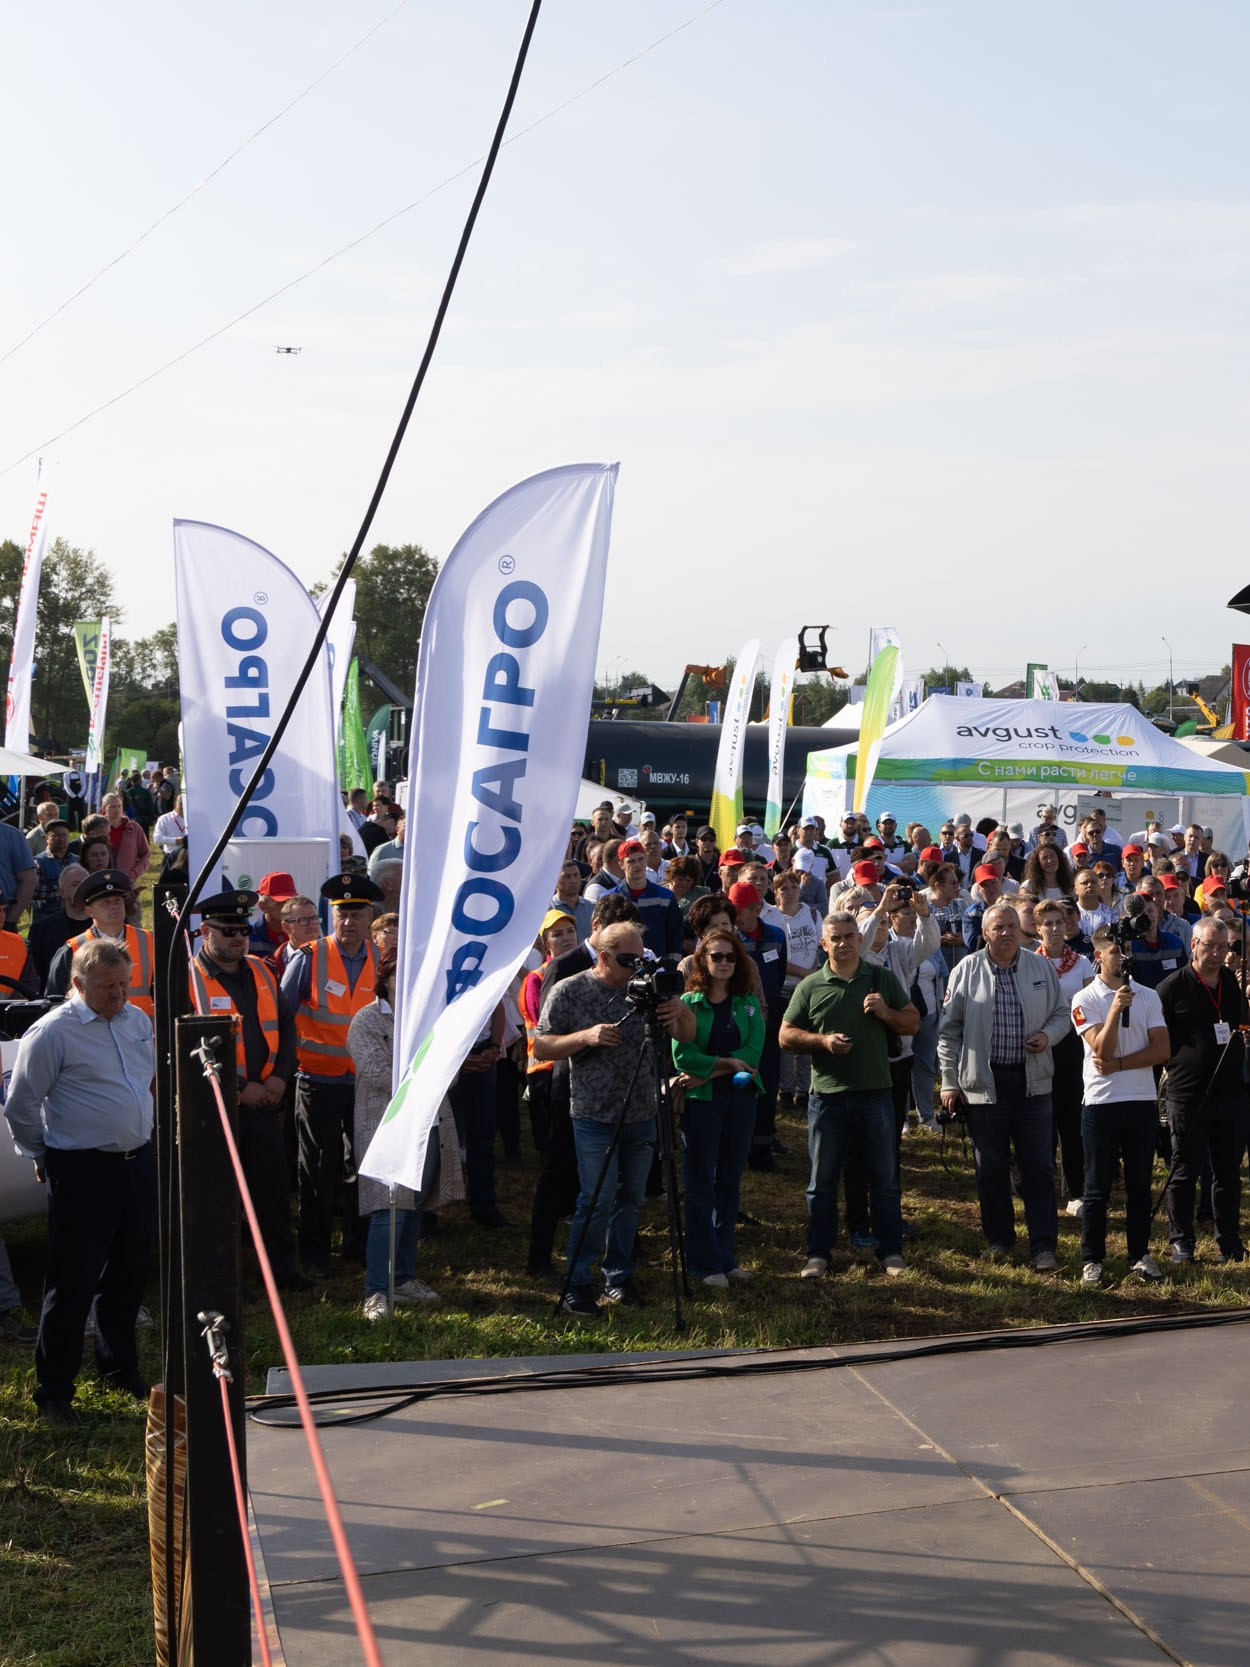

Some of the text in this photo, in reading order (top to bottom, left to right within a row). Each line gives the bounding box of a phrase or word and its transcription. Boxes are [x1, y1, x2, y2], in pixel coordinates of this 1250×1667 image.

[956, 725, 1063, 742] avgust
[1019, 742, 1140, 757] crop protection
[650, 773, 690, 785] МВЖУ-16
[978, 761, 1137, 781] С нами расти легче
